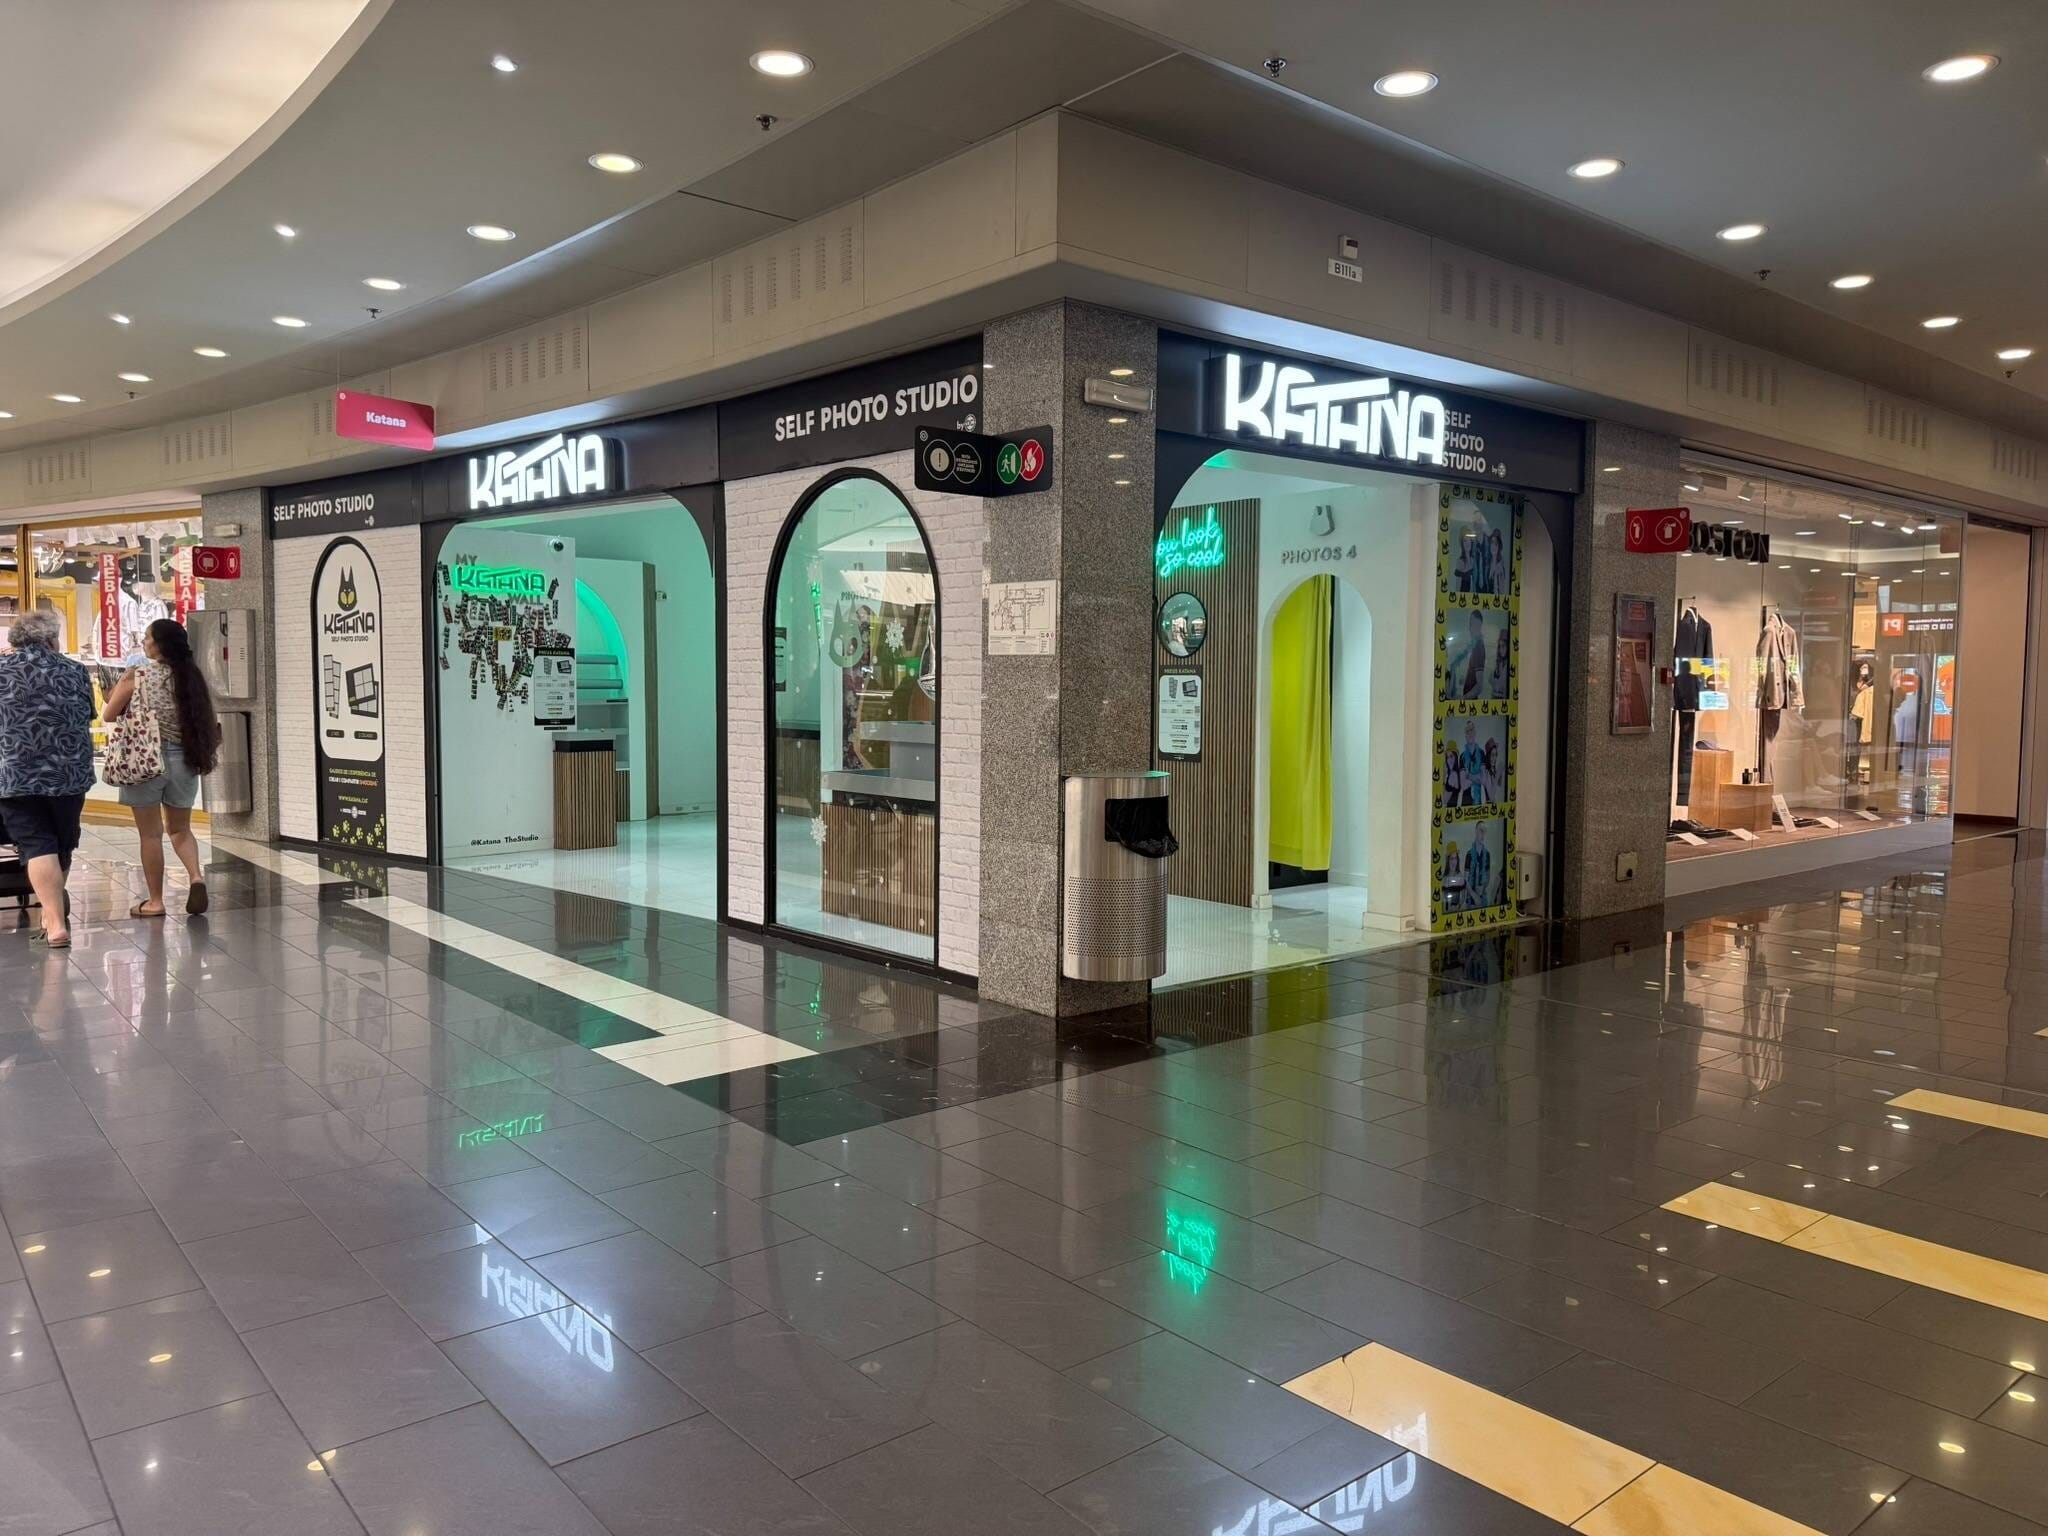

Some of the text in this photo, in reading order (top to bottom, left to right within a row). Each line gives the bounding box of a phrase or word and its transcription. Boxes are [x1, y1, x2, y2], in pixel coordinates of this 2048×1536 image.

[775, 374, 978, 442] SELF PHOTO STUDIO
[366, 411, 407, 428] Katana
[1443, 409, 1471, 429] SELF
[1442, 431, 1484, 452] PHOTO
[1441, 451, 1486, 473] STUDIO
[273, 494, 375, 522] SELF PHOTO STUDIO
[1182, 506, 1219, 549] look
[456, 553, 478, 566] MY
[1160, 534, 1224, 578] so cool
[1282, 544, 1358, 564] PHOTOS 4
[103, 554, 118, 657] REBAIXES
[508, 593, 543, 606] WALL
[470, 834, 539, 846] @Katana TheStudio
